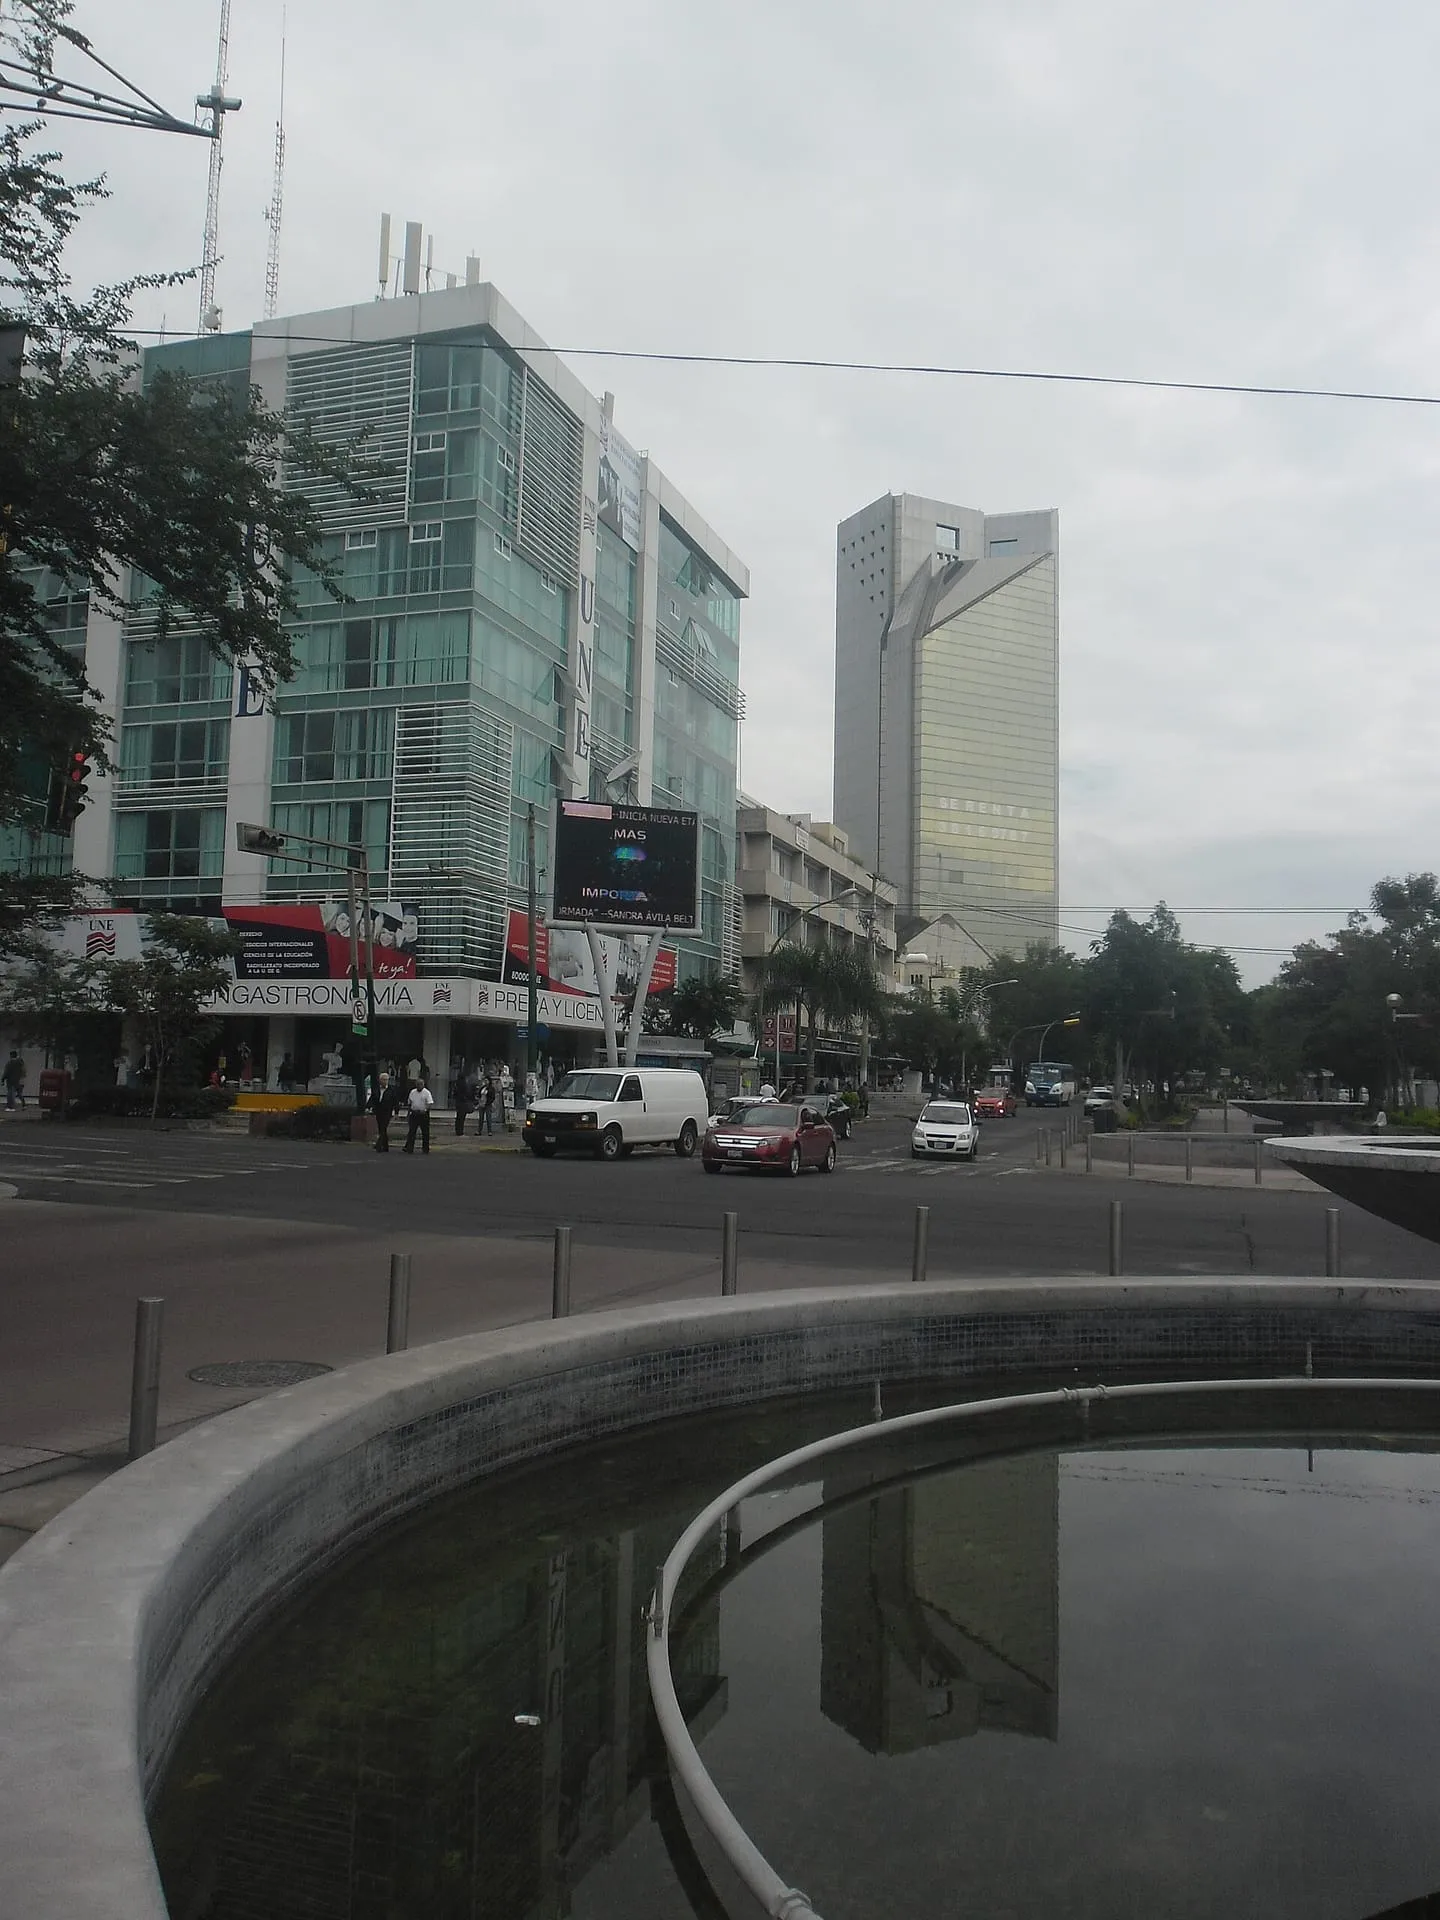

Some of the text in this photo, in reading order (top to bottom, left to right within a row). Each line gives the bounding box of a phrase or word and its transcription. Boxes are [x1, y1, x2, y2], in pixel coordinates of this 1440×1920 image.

[573, 572, 595, 761] UNE
[650, 813, 679, 825] NUEVA
[89, 919, 114, 931] UNE
[552, 998, 562, 1017] Y
